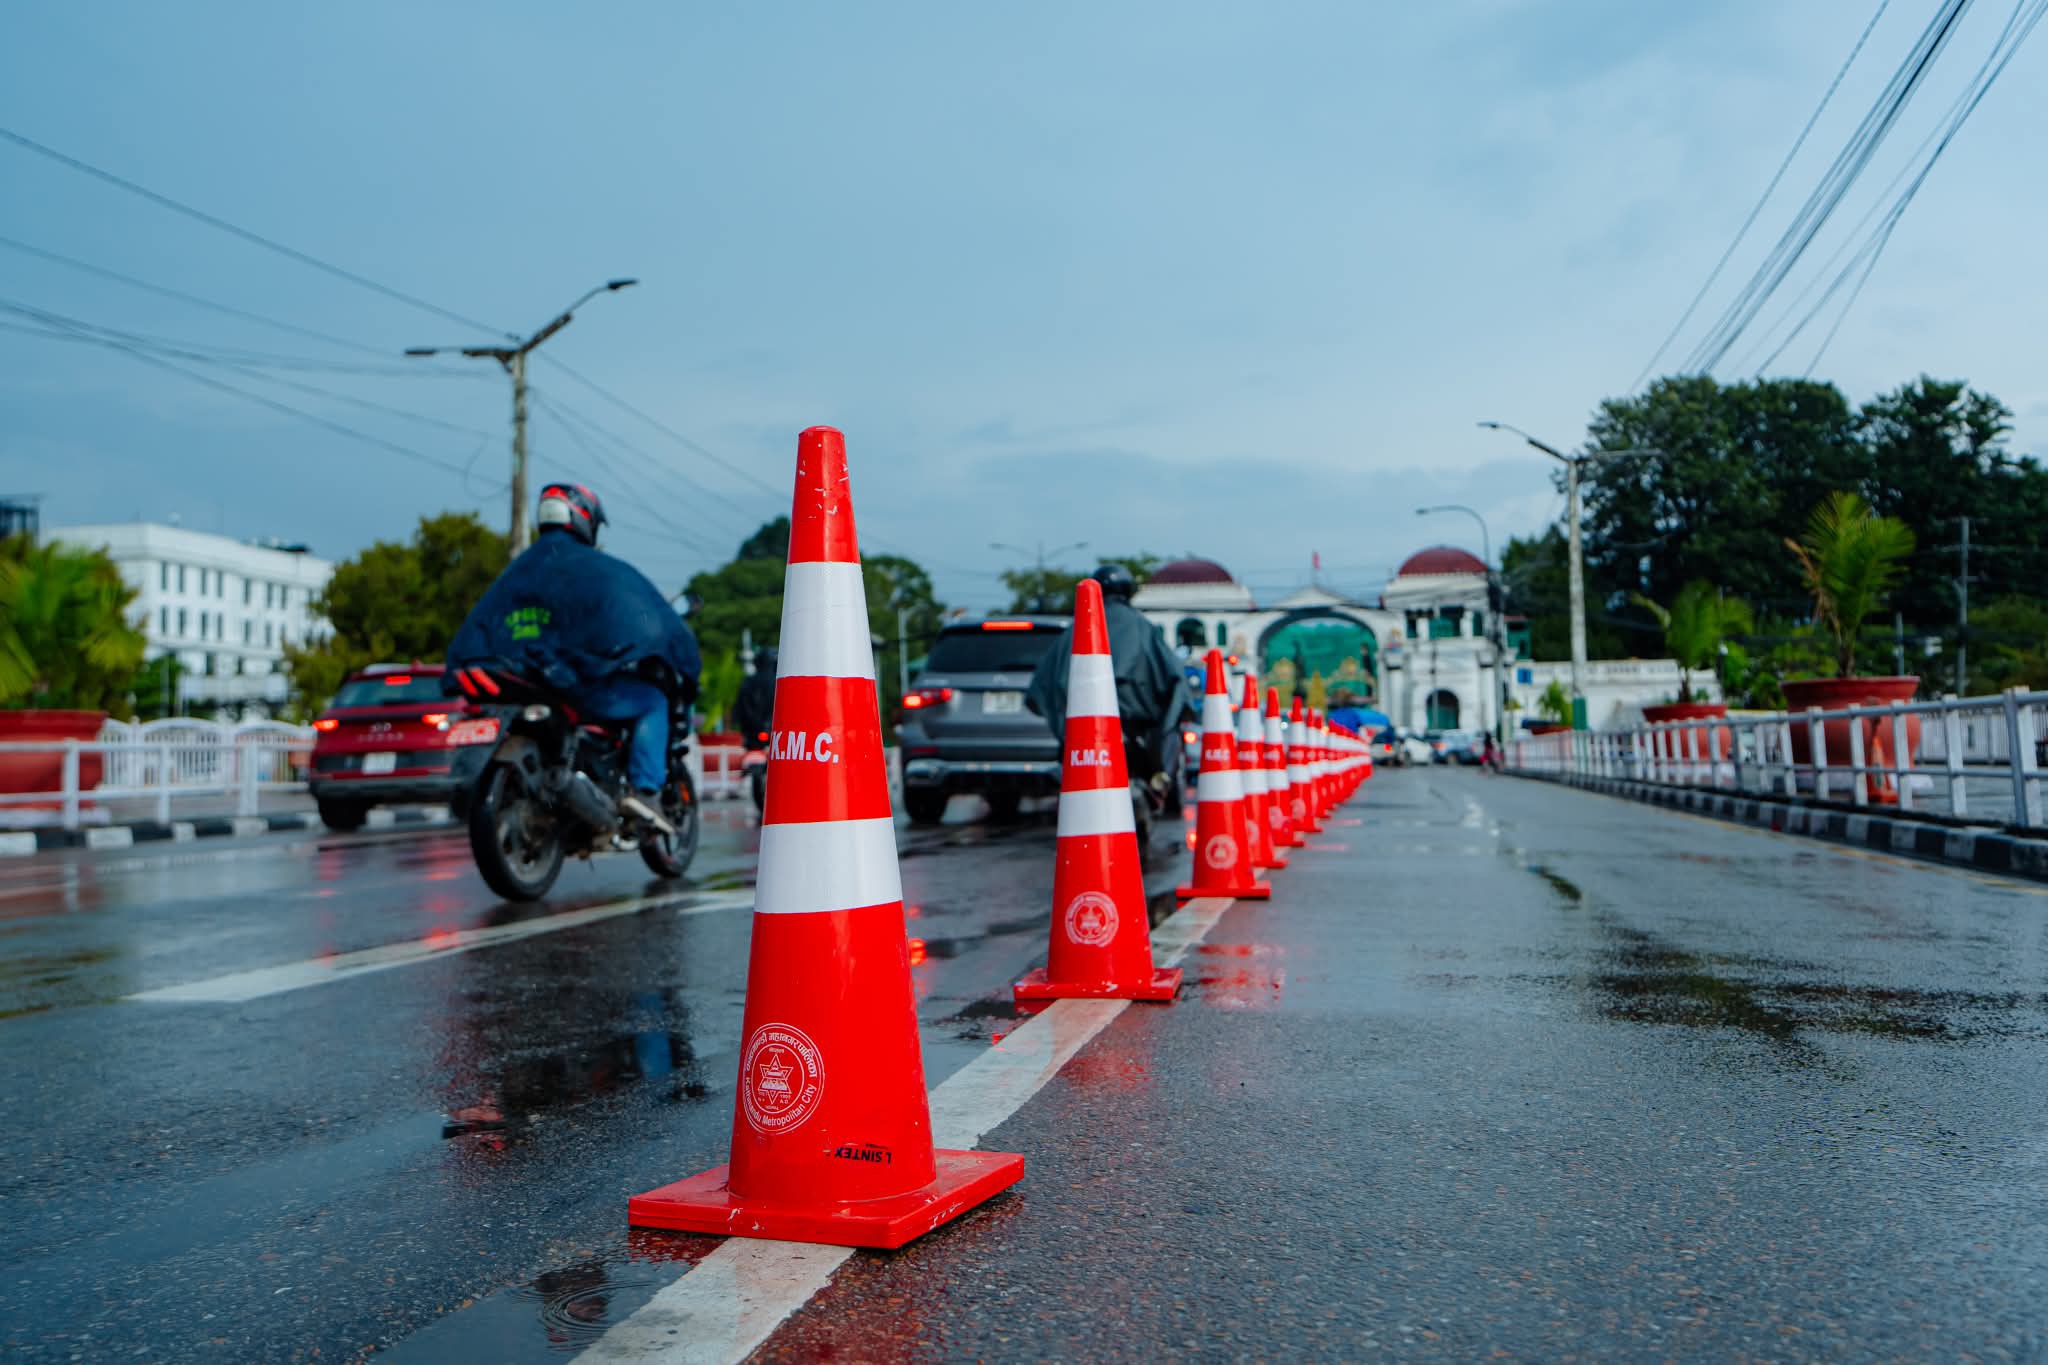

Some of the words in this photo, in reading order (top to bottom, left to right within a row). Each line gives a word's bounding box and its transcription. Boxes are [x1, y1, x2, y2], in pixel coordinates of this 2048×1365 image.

[771, 731, 839, 764] K.M.C.
[1070, 749, 1112, 767] K.M.C.
[762, 1103, 806, 1127] Metropolitan
[801, 1083, 817, 1104] City
